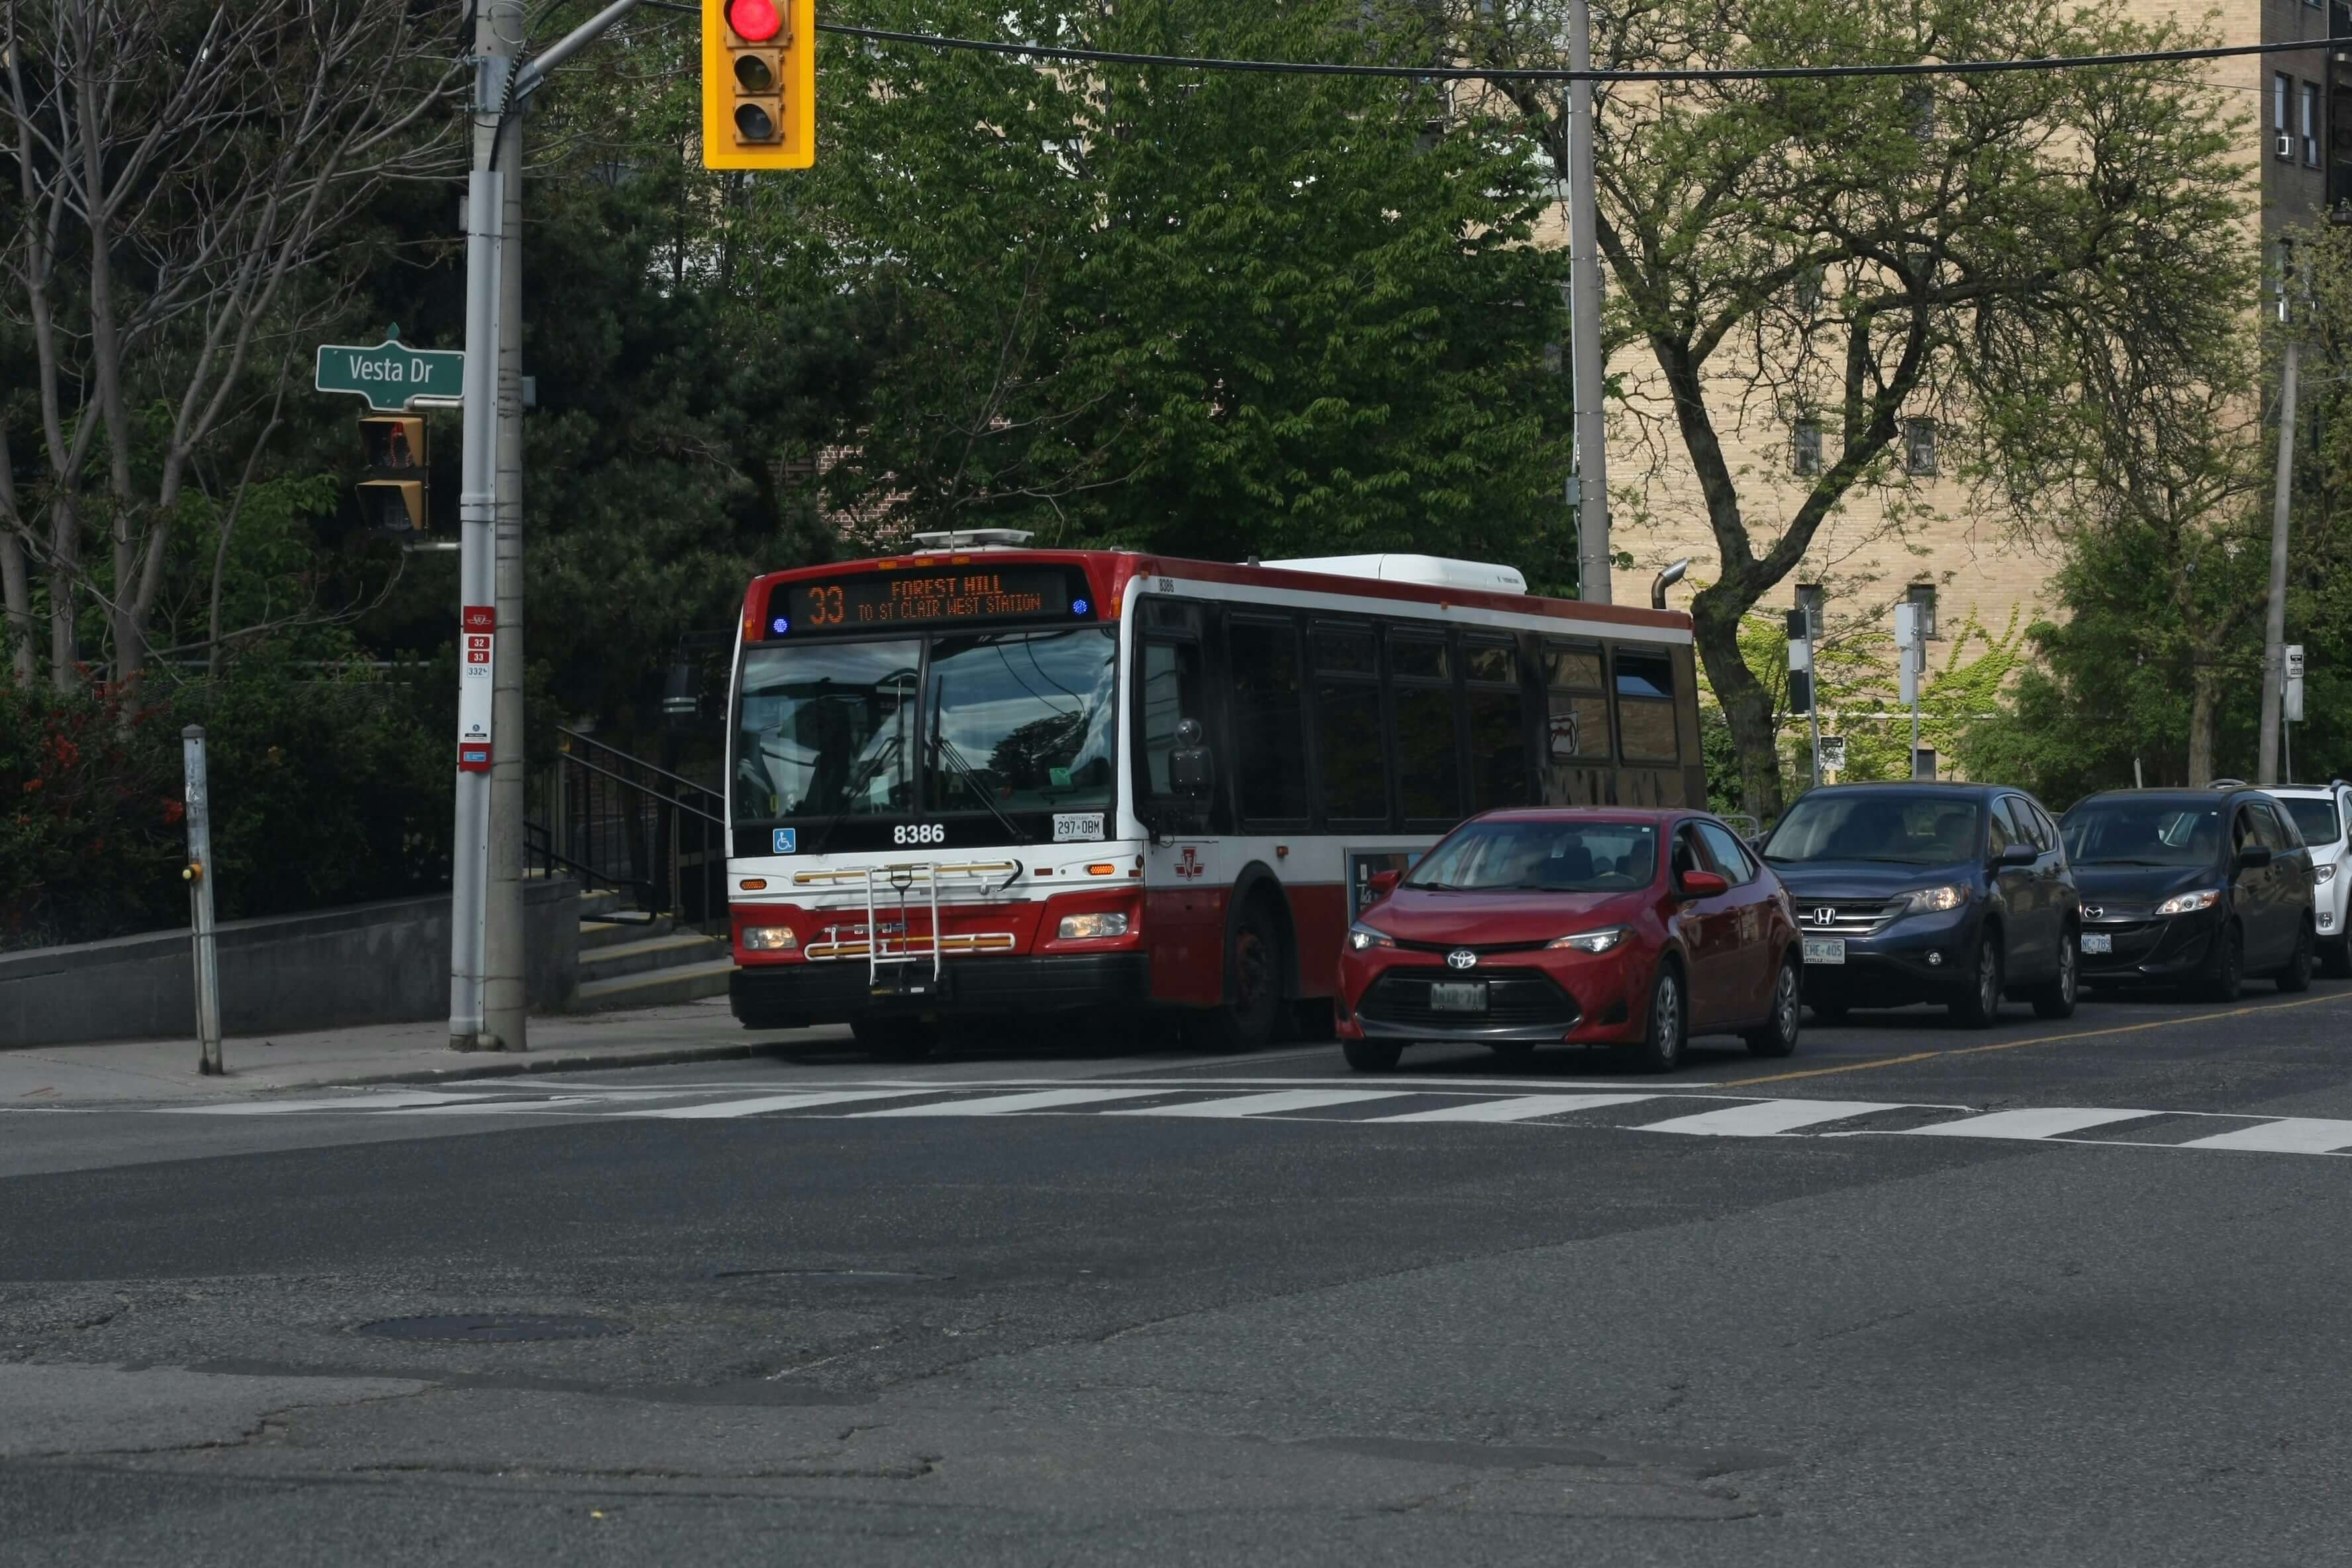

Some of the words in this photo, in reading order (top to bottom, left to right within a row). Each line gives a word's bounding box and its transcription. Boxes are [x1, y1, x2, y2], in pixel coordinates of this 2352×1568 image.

[350, 355, 403, 381] Vesta
[411, 358, 433, 383] Dr
[892, 577, 956, 601] FOREST
[964, 575, 1004, 596] HILL
[1159, 577, 1175, 593] 8386
[809, 586, 844, 624] 33
[858, 604, 873, 620] TO
[879, 602, 894, 620] ST
[901, 599, 941, 618] CLAIR
[947, 597, 979, 615] WEST
[986, 593, 1042, 614] STATION
[474, 638, 484, 647] 32
[473, 653, 483, 662] 33
[468, 667, 483, 675] 332
[894, 824, 945, 844] 8386
[1058, 821, 1075, 834] 297
[1826, 944, 1843, 957] 405
